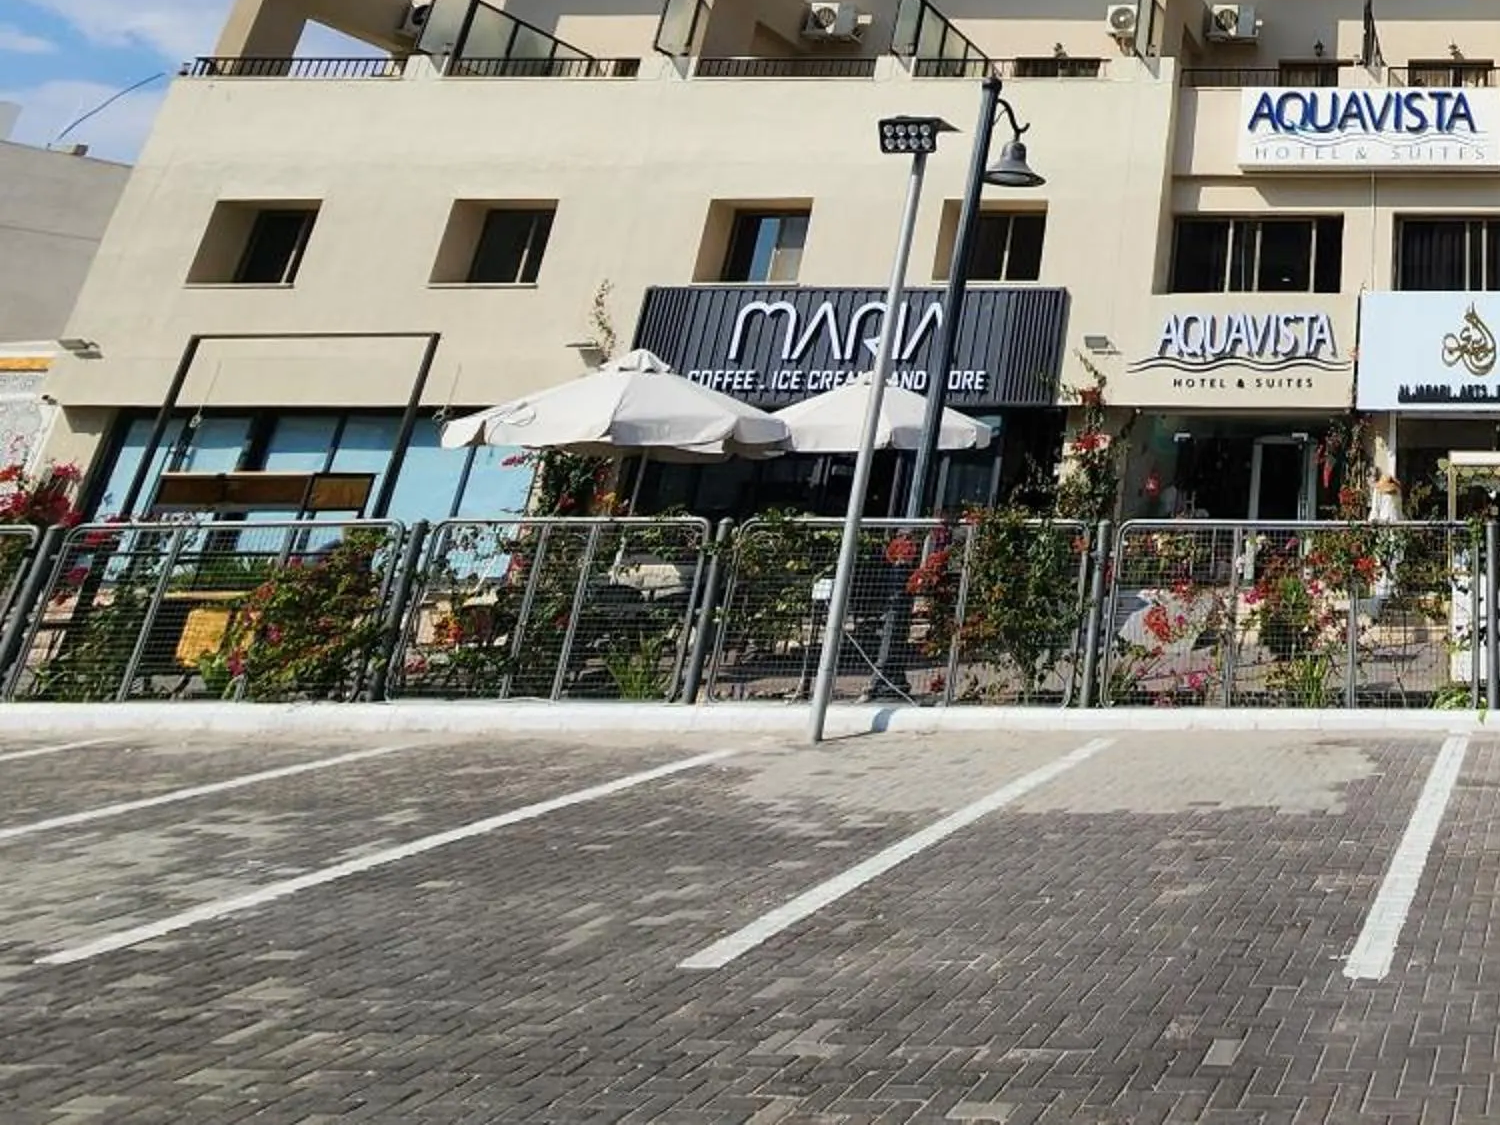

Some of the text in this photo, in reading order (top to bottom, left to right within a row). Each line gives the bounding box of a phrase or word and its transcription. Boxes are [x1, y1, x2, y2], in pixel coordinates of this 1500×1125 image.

[1247, 90, 1477, 133] AQUAVISTA
[1254, 145, 1486, 161] HOTEL & SUITES
[1157, 313, 1338, 360] AQUAVISTA
[687, 370, 755, 391] COFFEE
[771, 370, 803, 391] ICE
[885, 370, 928, 390] AND
[946, 370, 987, 391] ORE
[1173, 377, 1314, 389] HOTEL & SUITES
